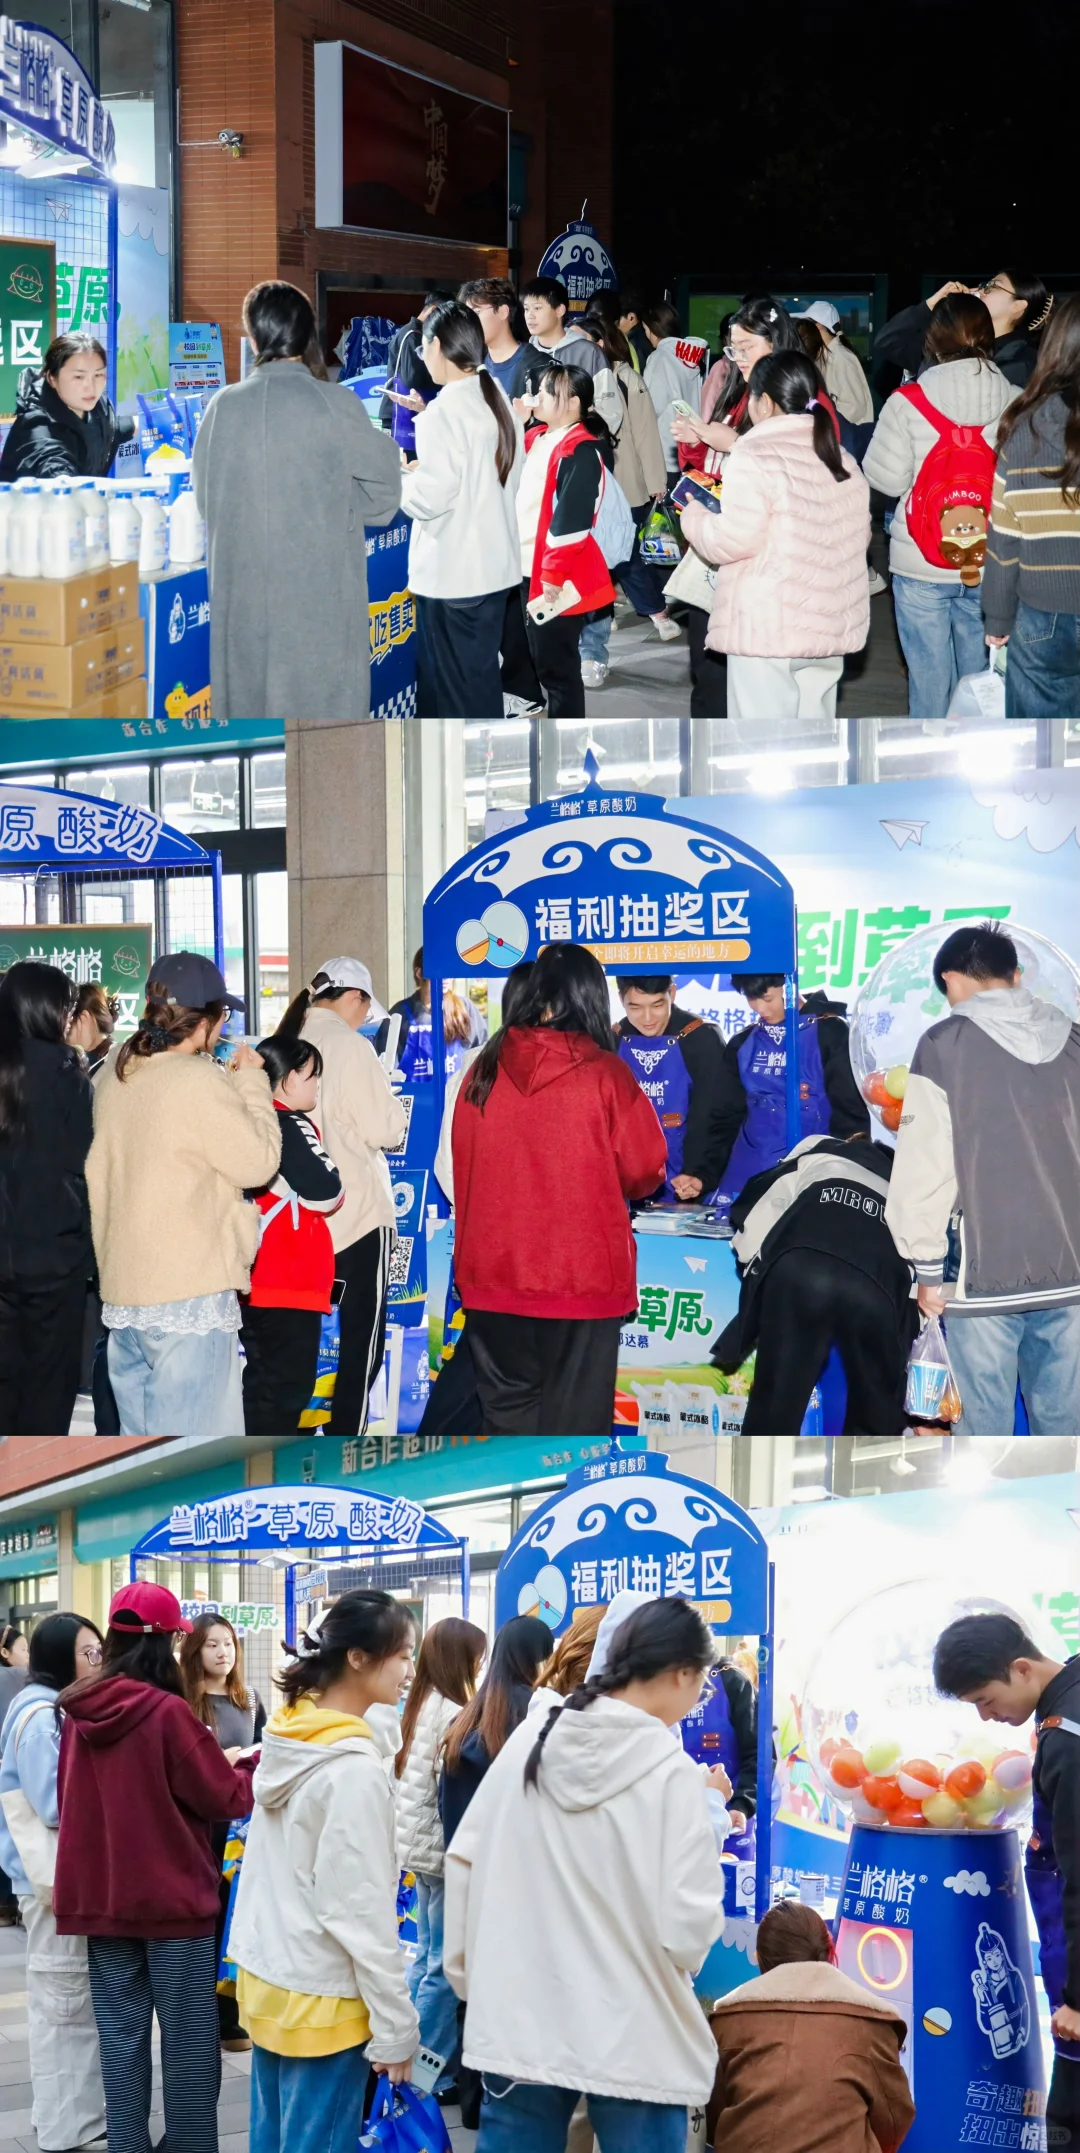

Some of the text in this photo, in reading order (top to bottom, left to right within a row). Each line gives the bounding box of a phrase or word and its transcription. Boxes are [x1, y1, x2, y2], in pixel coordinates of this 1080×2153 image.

[944, 490, 982, 504] BAMBOO
[0, 804, 162, 861] 原酸奶
[535, 889, 751, 941] 福利抽奖区
[637, 1286, 713, 1341] 草原
[571, 1547, 732, 1603] 福利抽奖区
[843, 1898, 909, 1924] 草原酸奶
